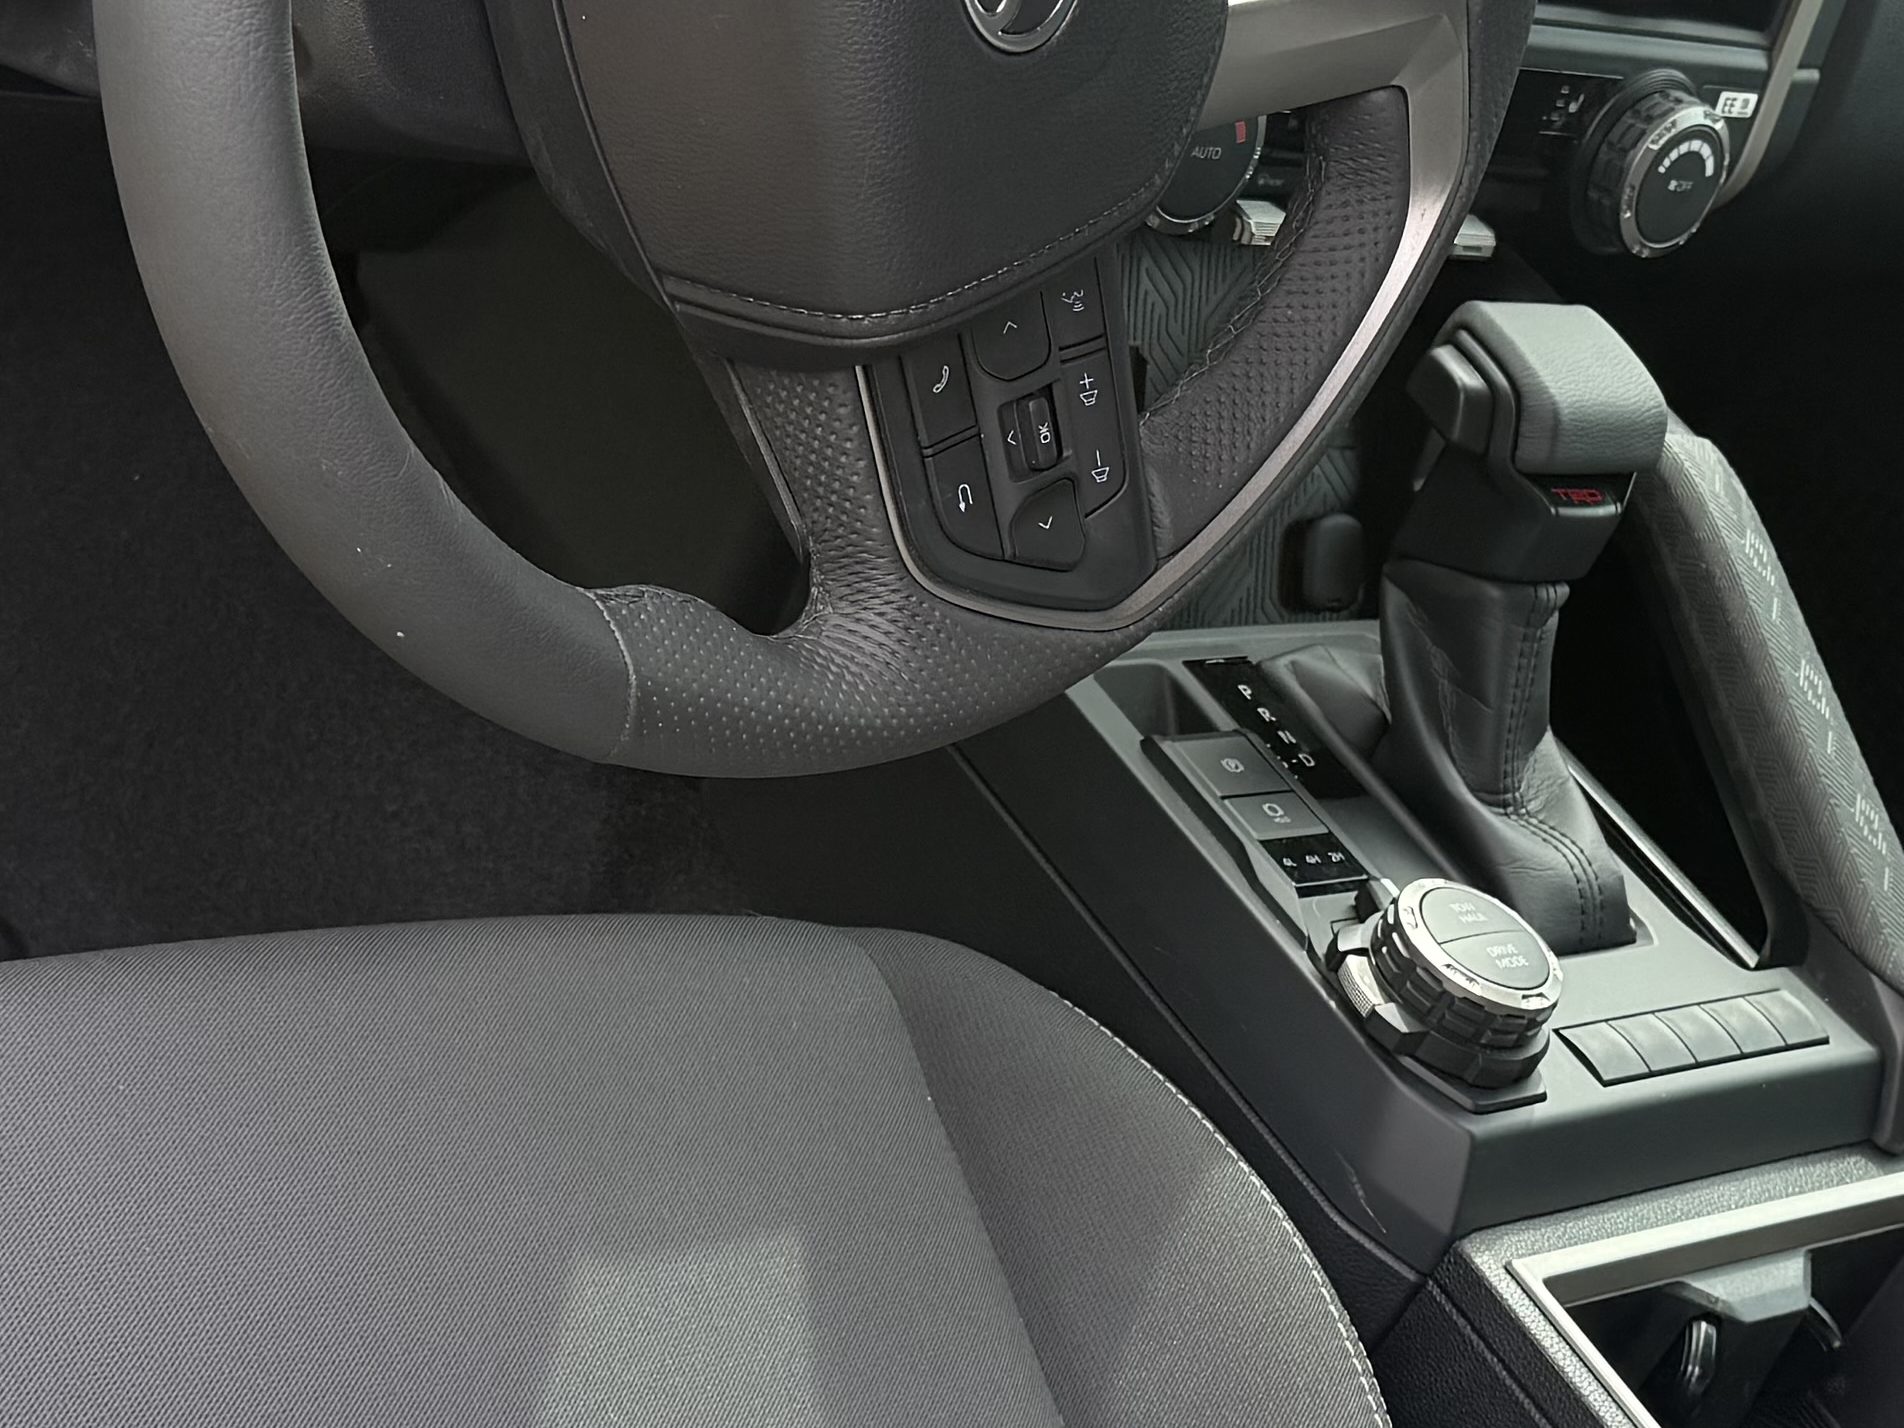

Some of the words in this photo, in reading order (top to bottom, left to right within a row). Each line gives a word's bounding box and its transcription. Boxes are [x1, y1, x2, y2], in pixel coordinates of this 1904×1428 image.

[1191, 146, 1222, 160] AUTO
[1038, 422, 1051, 444] OK
[1238, 684, 1253, 700] P
[1257, 707, 1276, 722] R
[1277, 730, 1296, 744] N
[1298, 753, 1316, 767] D
